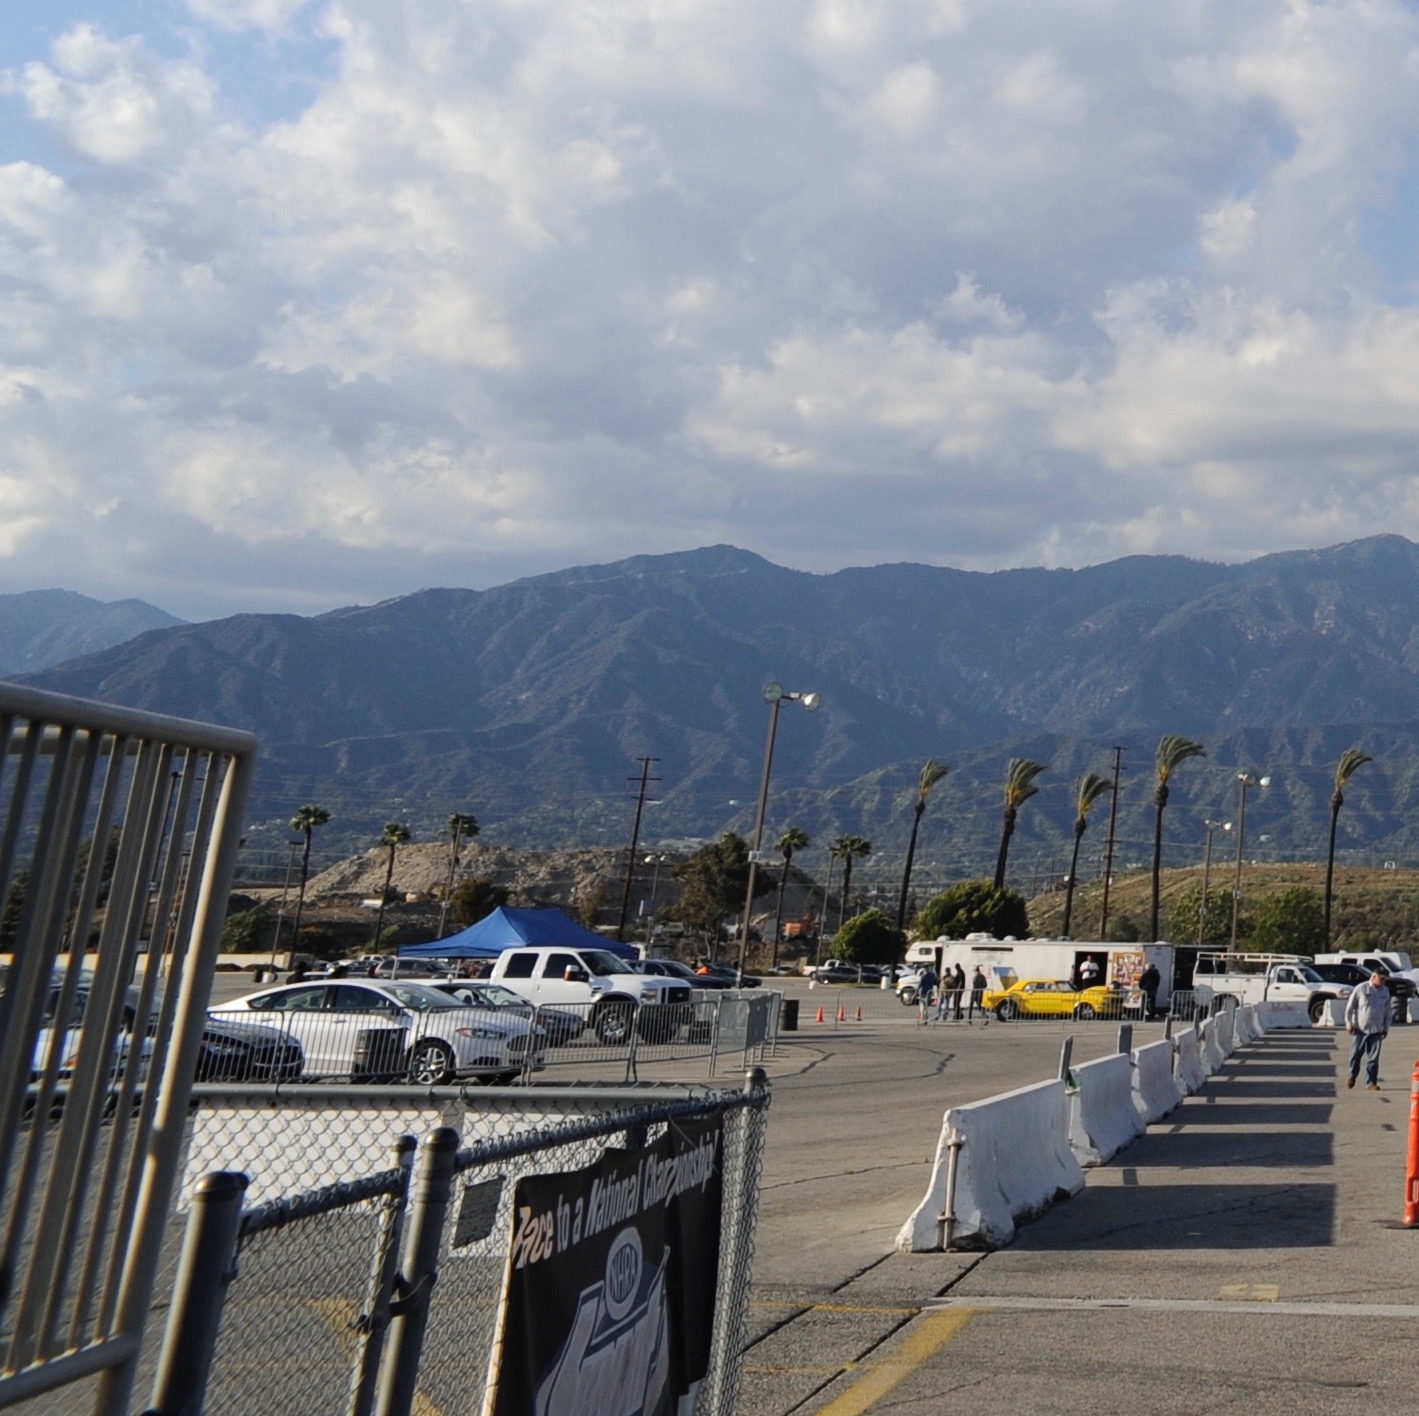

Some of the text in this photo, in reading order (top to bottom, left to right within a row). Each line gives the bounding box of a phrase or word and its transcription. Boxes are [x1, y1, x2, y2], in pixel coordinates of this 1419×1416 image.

[557, 1193, 571, 1254] to
[572, 1196, 584, 1245] a
[584, 1158, 644, 1238] National
